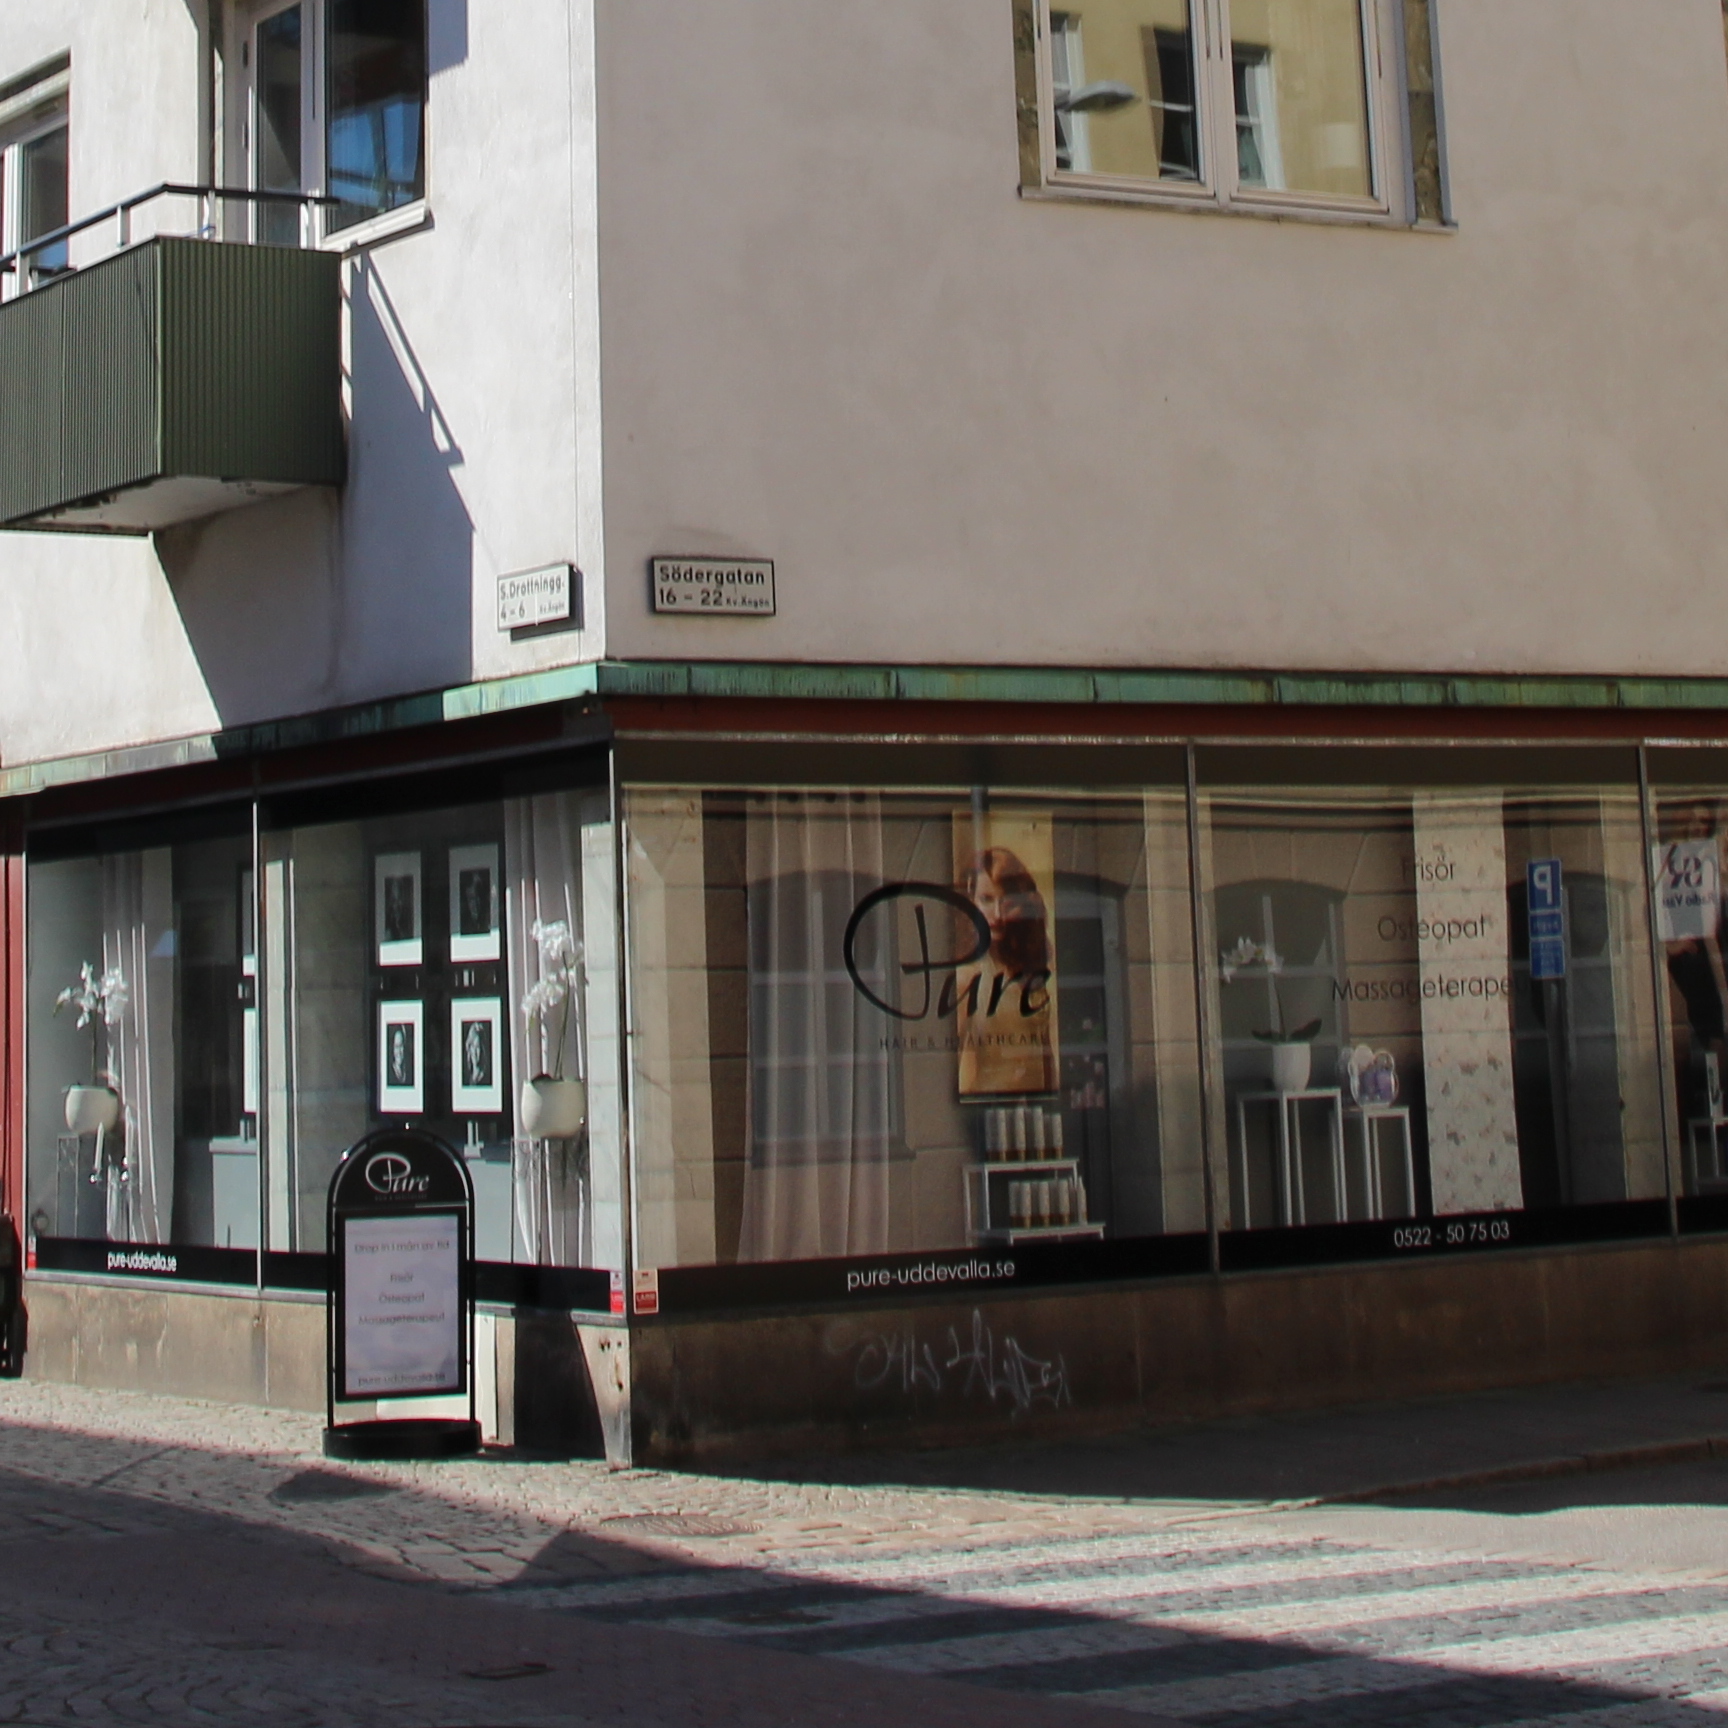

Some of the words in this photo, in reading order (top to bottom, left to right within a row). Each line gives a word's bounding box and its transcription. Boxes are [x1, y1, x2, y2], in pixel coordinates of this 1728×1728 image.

[659, 565, 765, 588] Södergatan
[519, 601, 525, 618] 6
[659, 587, 677, 605] 16
[701, 588, 723, 606] 22
[1377, 914, 1486, 945] Osteopat
[843, 881, 1051, 1020] Pure
[365, 1152, 430, 1193] Pure
[1394, 1227, 1431, 1248] 0522
[1446, 1223, 1465, 1244] 50
[1469, 1222, 1487, 1241] 75
[1491, 1220, 1510, 1240] 03
[107, 1251, 177, 1272] pure-uddevalla.se
[847, 1258, 1016, 1292] pure-uddevalla.se
